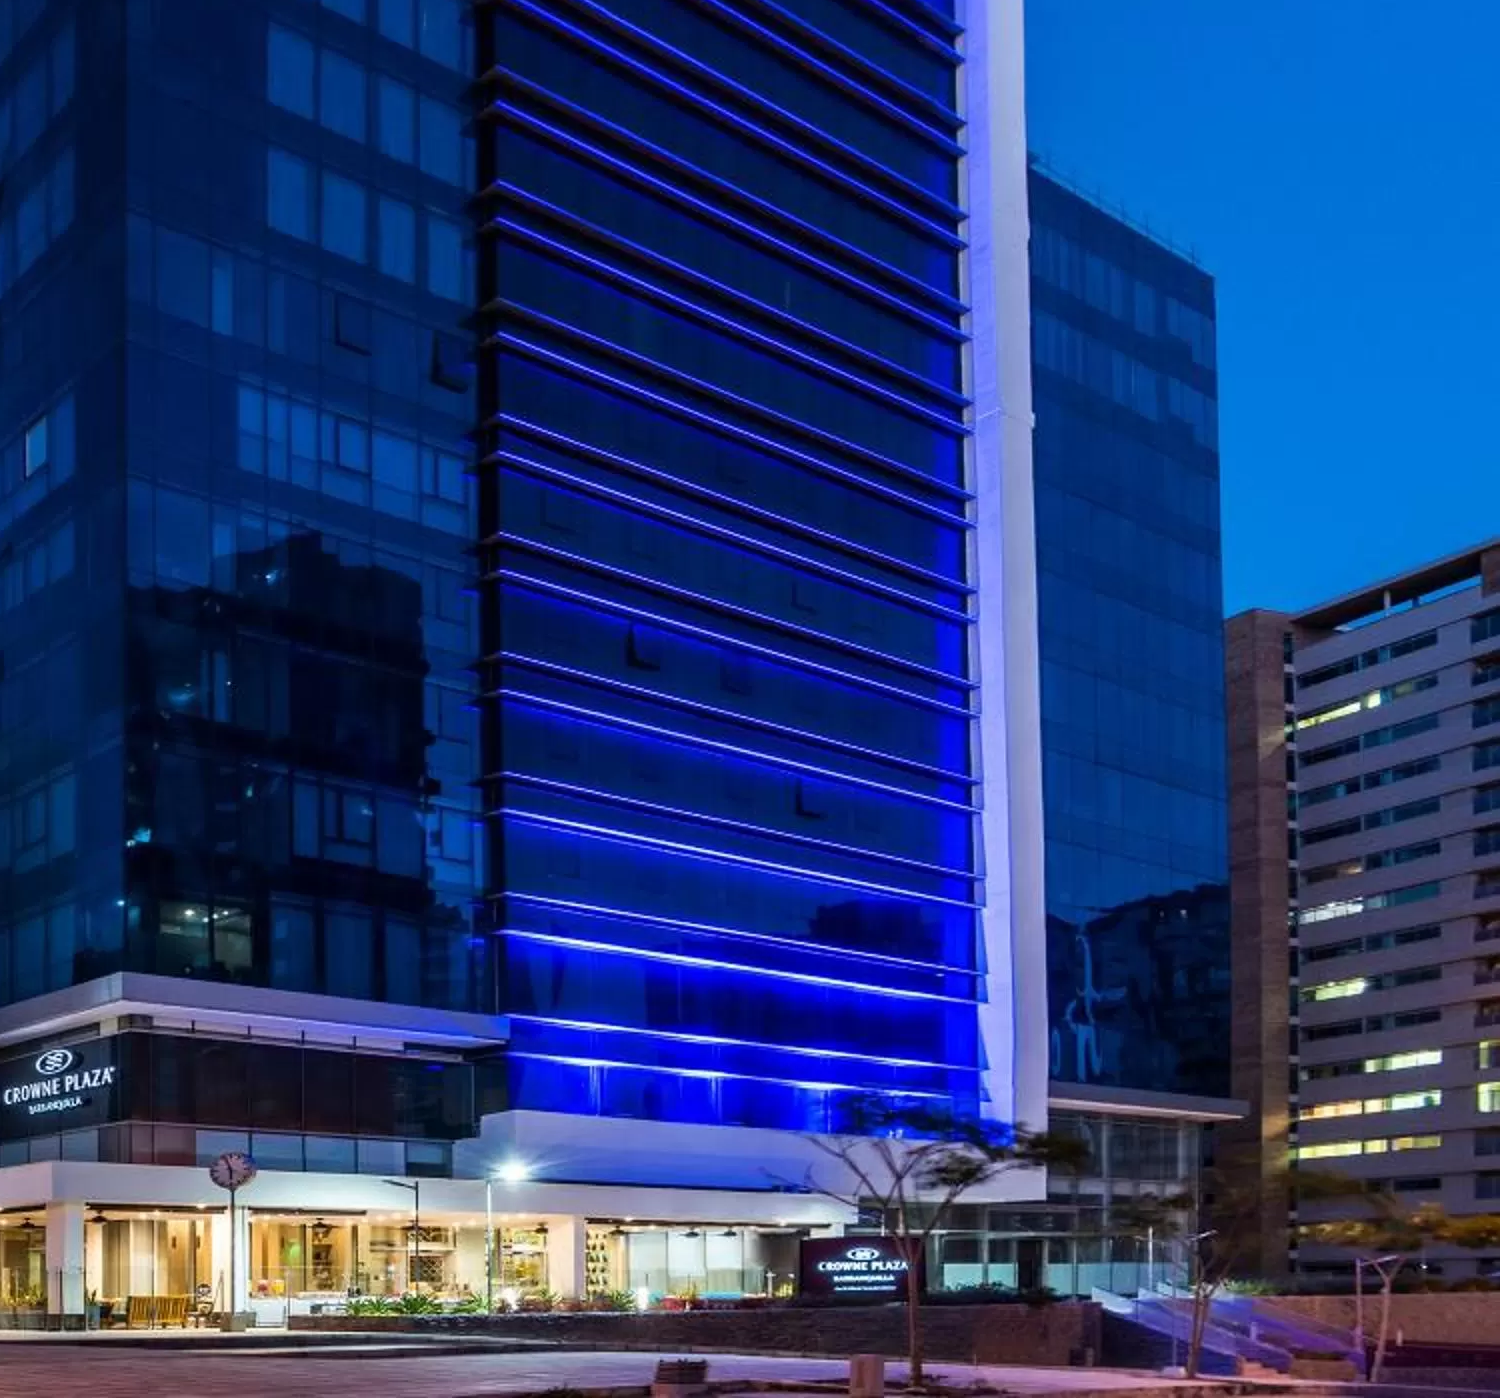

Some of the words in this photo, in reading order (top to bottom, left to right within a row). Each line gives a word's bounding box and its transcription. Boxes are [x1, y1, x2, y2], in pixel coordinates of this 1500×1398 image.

[3, 1077, 61, 1105] CROWNE
[65, 1067, 113, 1092] PLAZA
[817, 1261, 869, 1271] CROWNE
[872, 1260, 909, 1271] PLAZA
